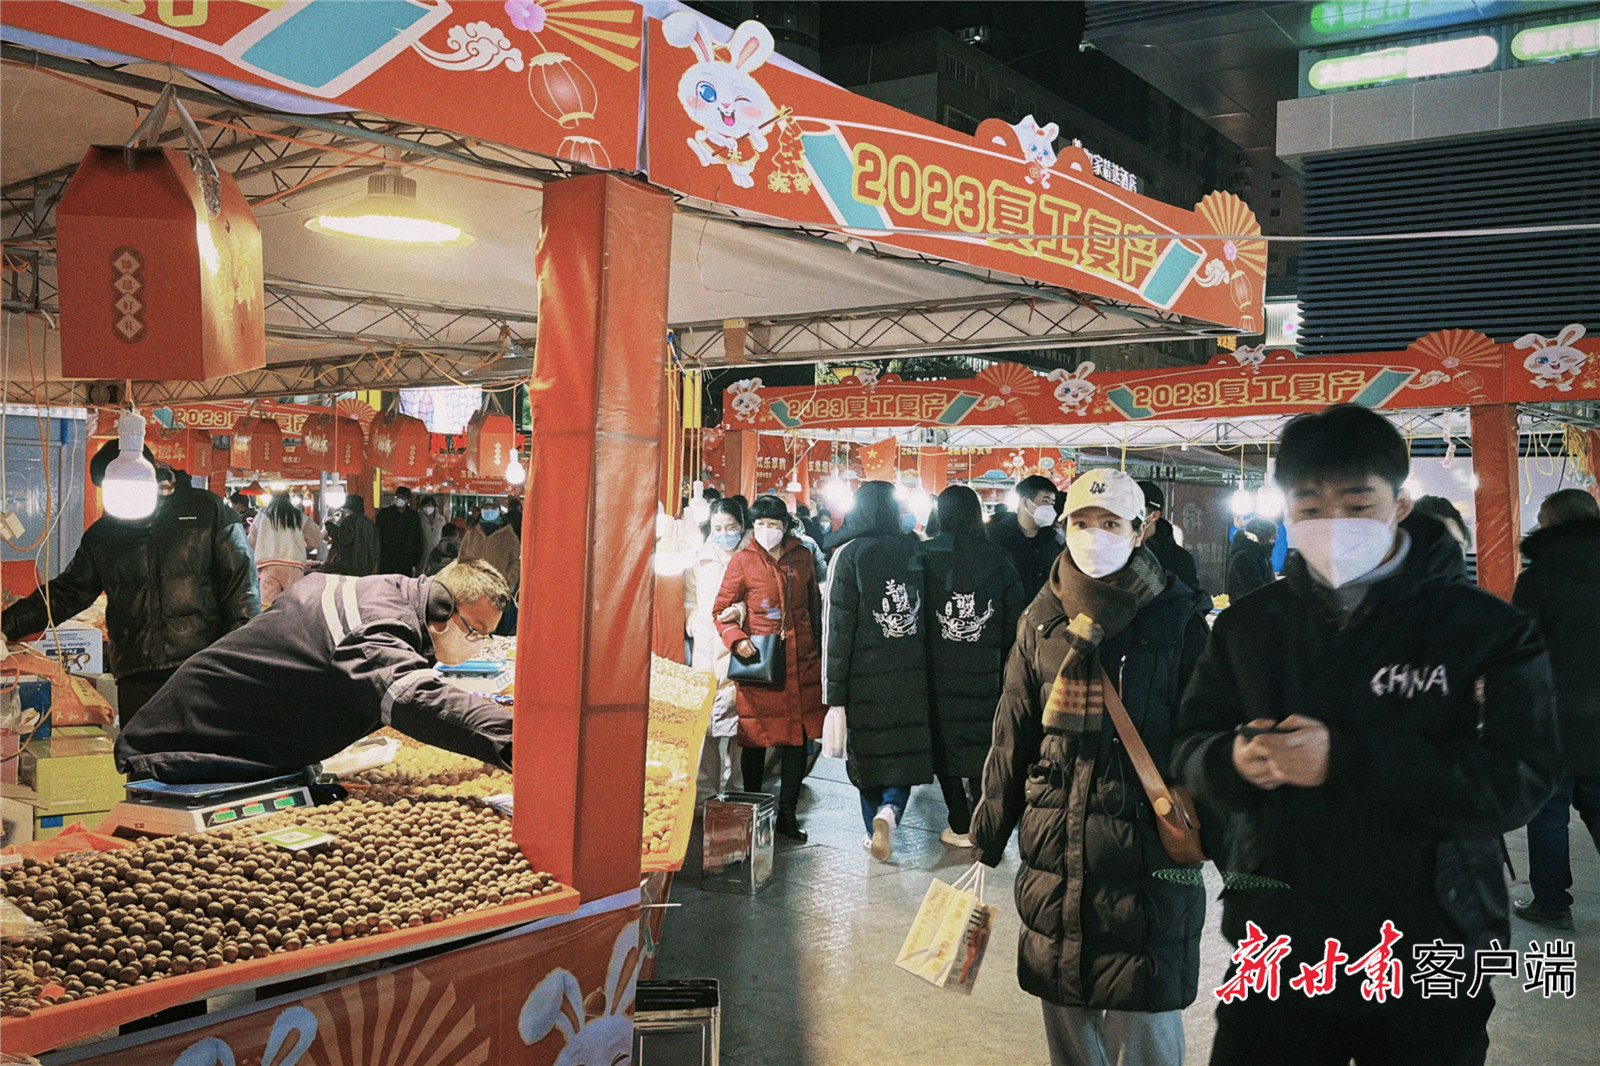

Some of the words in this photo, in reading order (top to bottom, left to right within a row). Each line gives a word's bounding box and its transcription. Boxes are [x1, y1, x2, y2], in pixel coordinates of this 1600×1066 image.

[851, 142, 1158, 283] 2023复工复产
[787, 392, 949, 420] 2023复工复产
[1132, 370, 1366, 408] 2023复工复产
